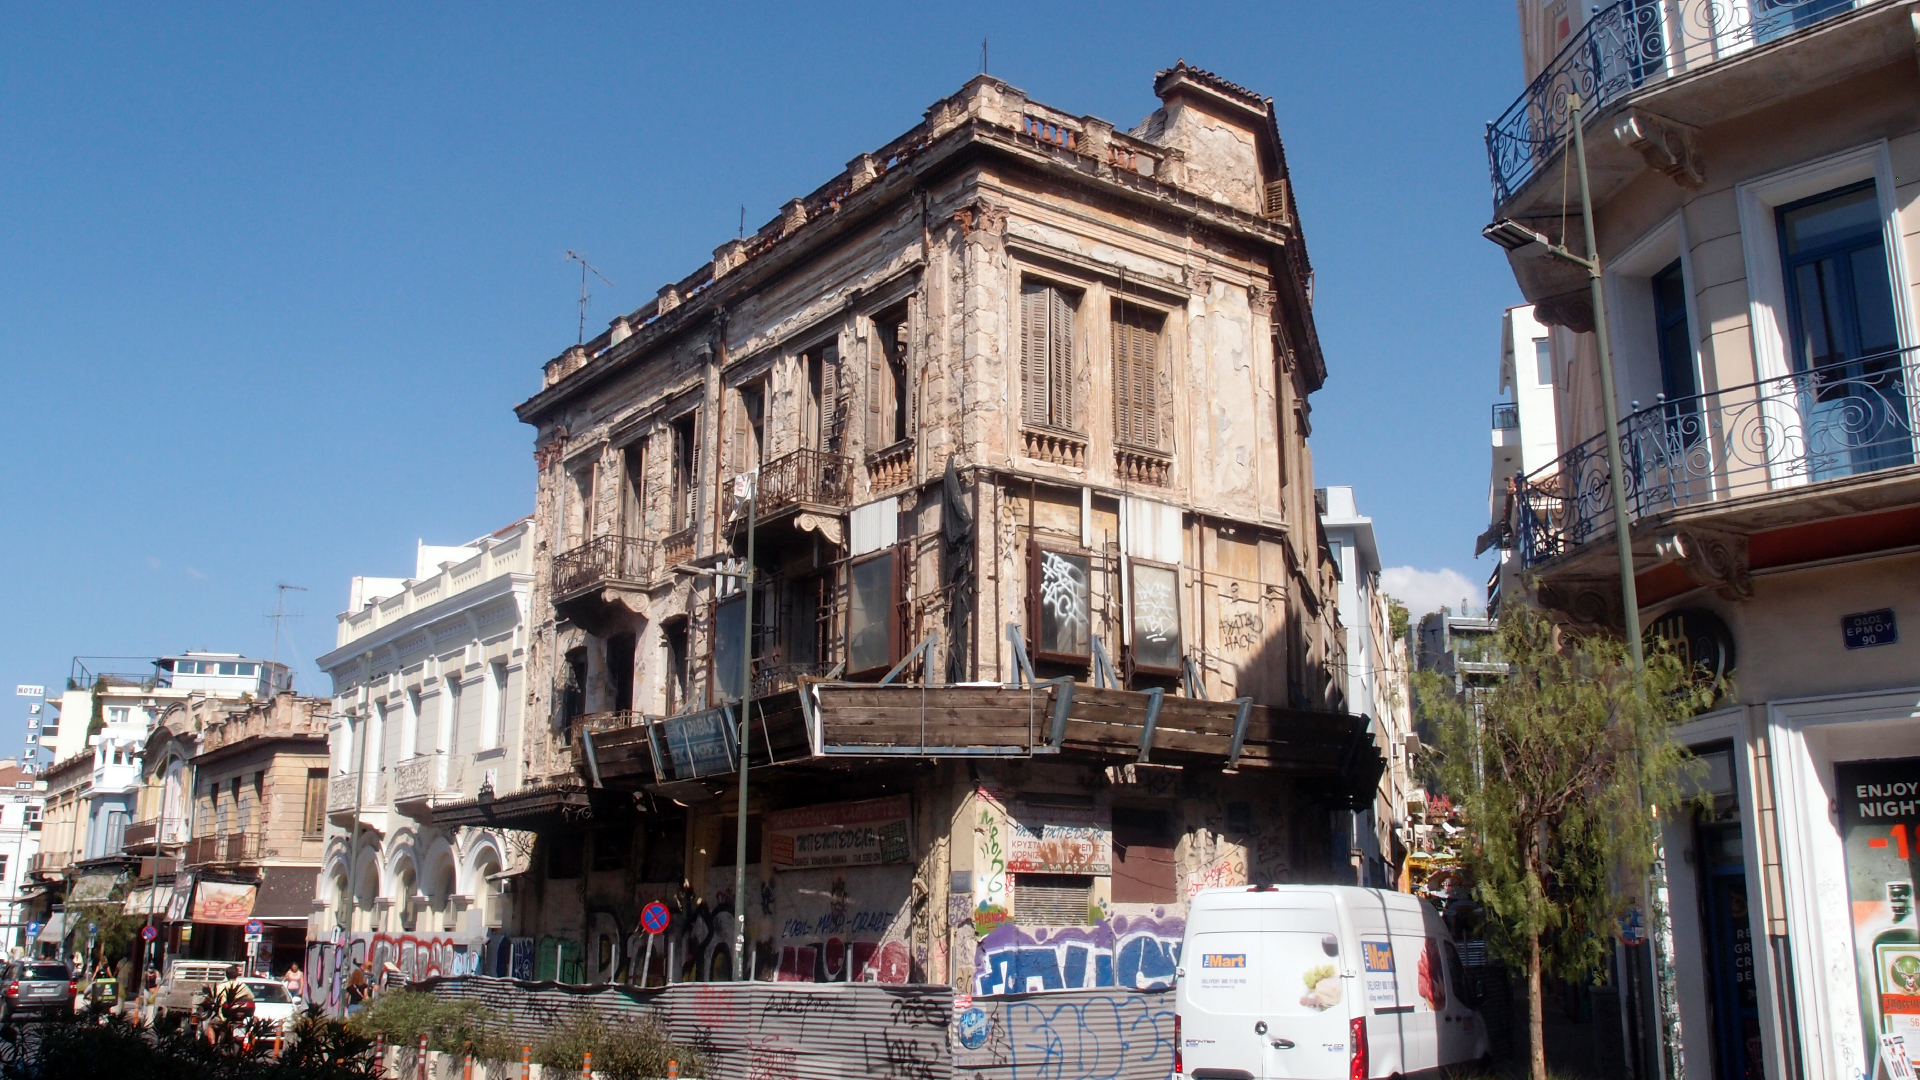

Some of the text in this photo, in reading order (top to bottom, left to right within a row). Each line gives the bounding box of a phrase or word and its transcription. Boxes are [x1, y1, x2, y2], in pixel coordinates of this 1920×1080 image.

[1846, 622, 1891, 637] ΕΡΜΟΥ
[1862, 634, 1876, 645] 90
[18, 687, 42, 695] HOTEL
[22, 704, 42, 774] PELLA
[1856, 782, 1918, 798] ENJOY
[1209, 954, 1245, 967] Mart
[1363, 943, 1371, 969] The
